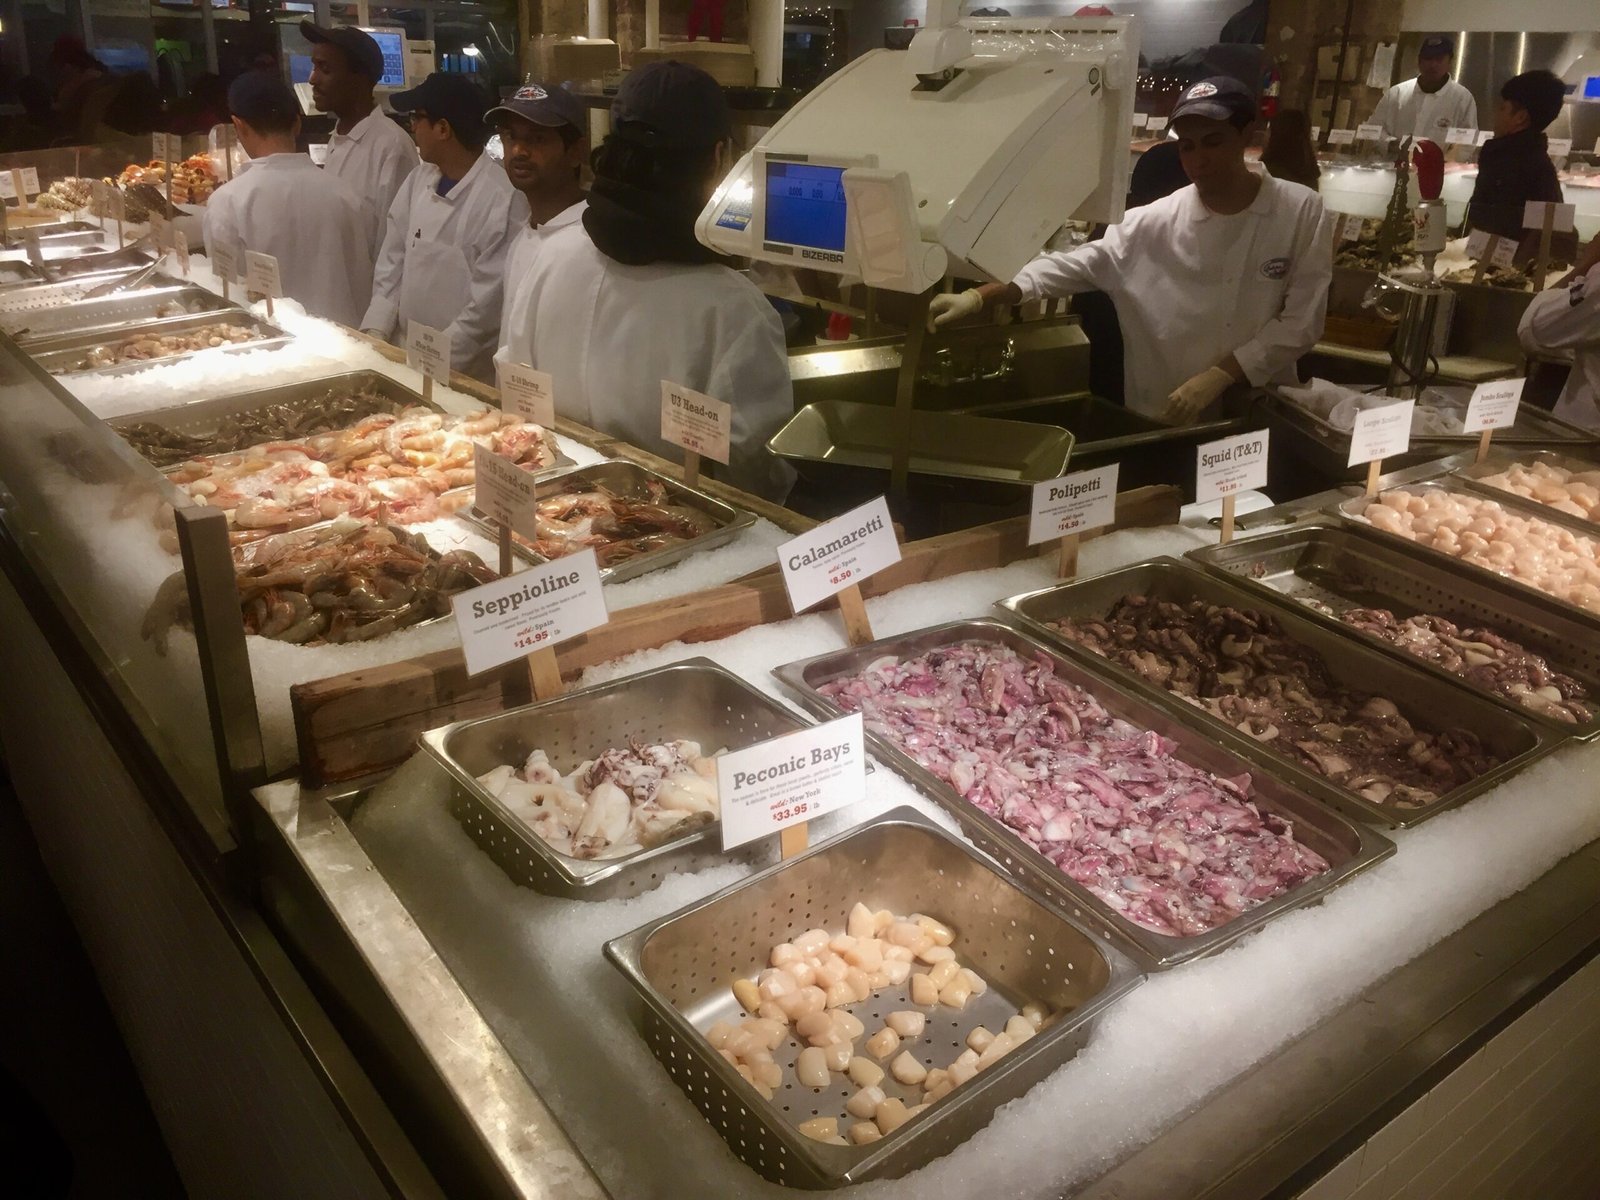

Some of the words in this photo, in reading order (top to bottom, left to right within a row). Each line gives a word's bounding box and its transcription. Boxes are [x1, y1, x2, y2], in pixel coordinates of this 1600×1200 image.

[801, 249, 844, 264] BIZERBA
[670, 393, 682, 408] U3
[682, 398, 719, 422] Head-on
[1201, 448, 1231, 468] Squid
[1233, 440, 1263, 462] (T&T)
[1048, 476, 1102, 502] Polipetti
[788, 514, 885, 572] Calamaretti
[842, 556, 858, 568] Spain
[829, 570, 853, 585] $8.50
[472, 569, 581, 619] Seppioline
[535, 618, 555, 631] Spain
[513, 630, 549, 649] $14.95
[733, 755, 807, 790] Peconic
[810, 742, 851, 767] Bays
[770, 799, 789, 811] wild:
[789, 793, 805, 804] New
[805, 787, 822, 800] York
[772, 803, 808, 822] $33.95
